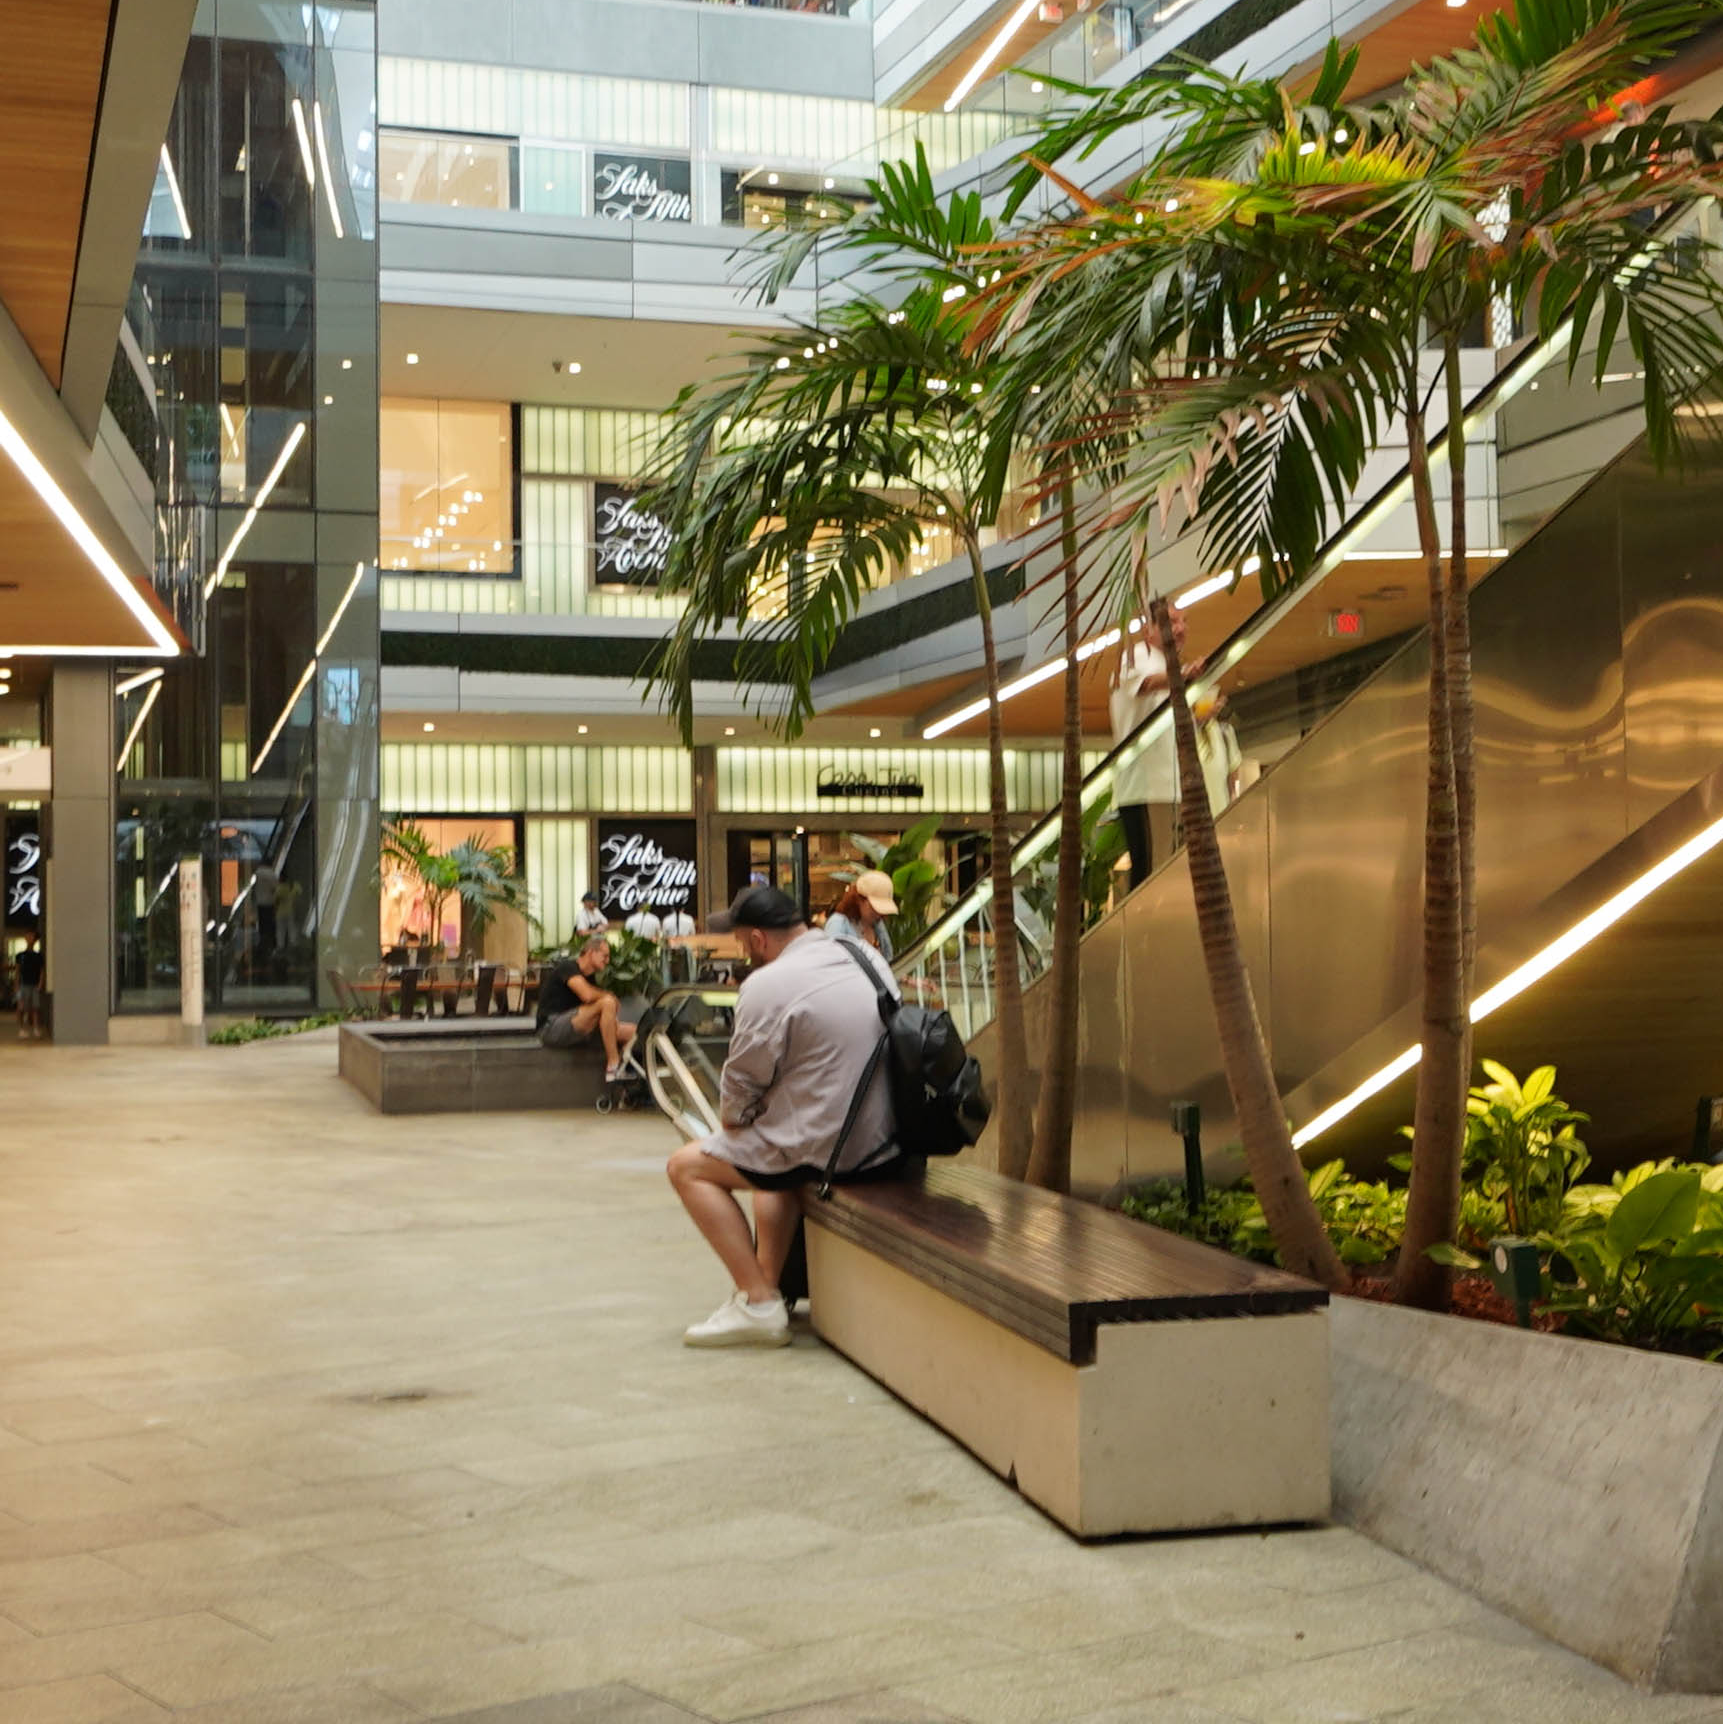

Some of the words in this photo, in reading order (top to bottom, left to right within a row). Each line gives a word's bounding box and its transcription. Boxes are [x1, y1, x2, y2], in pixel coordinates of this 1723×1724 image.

[596, 163, 658, 206] Saks
[600, 834, 663, 875] Saks
[640, 857, 697, 891] Fifth
[600, 873, 690, 911] Avenue
